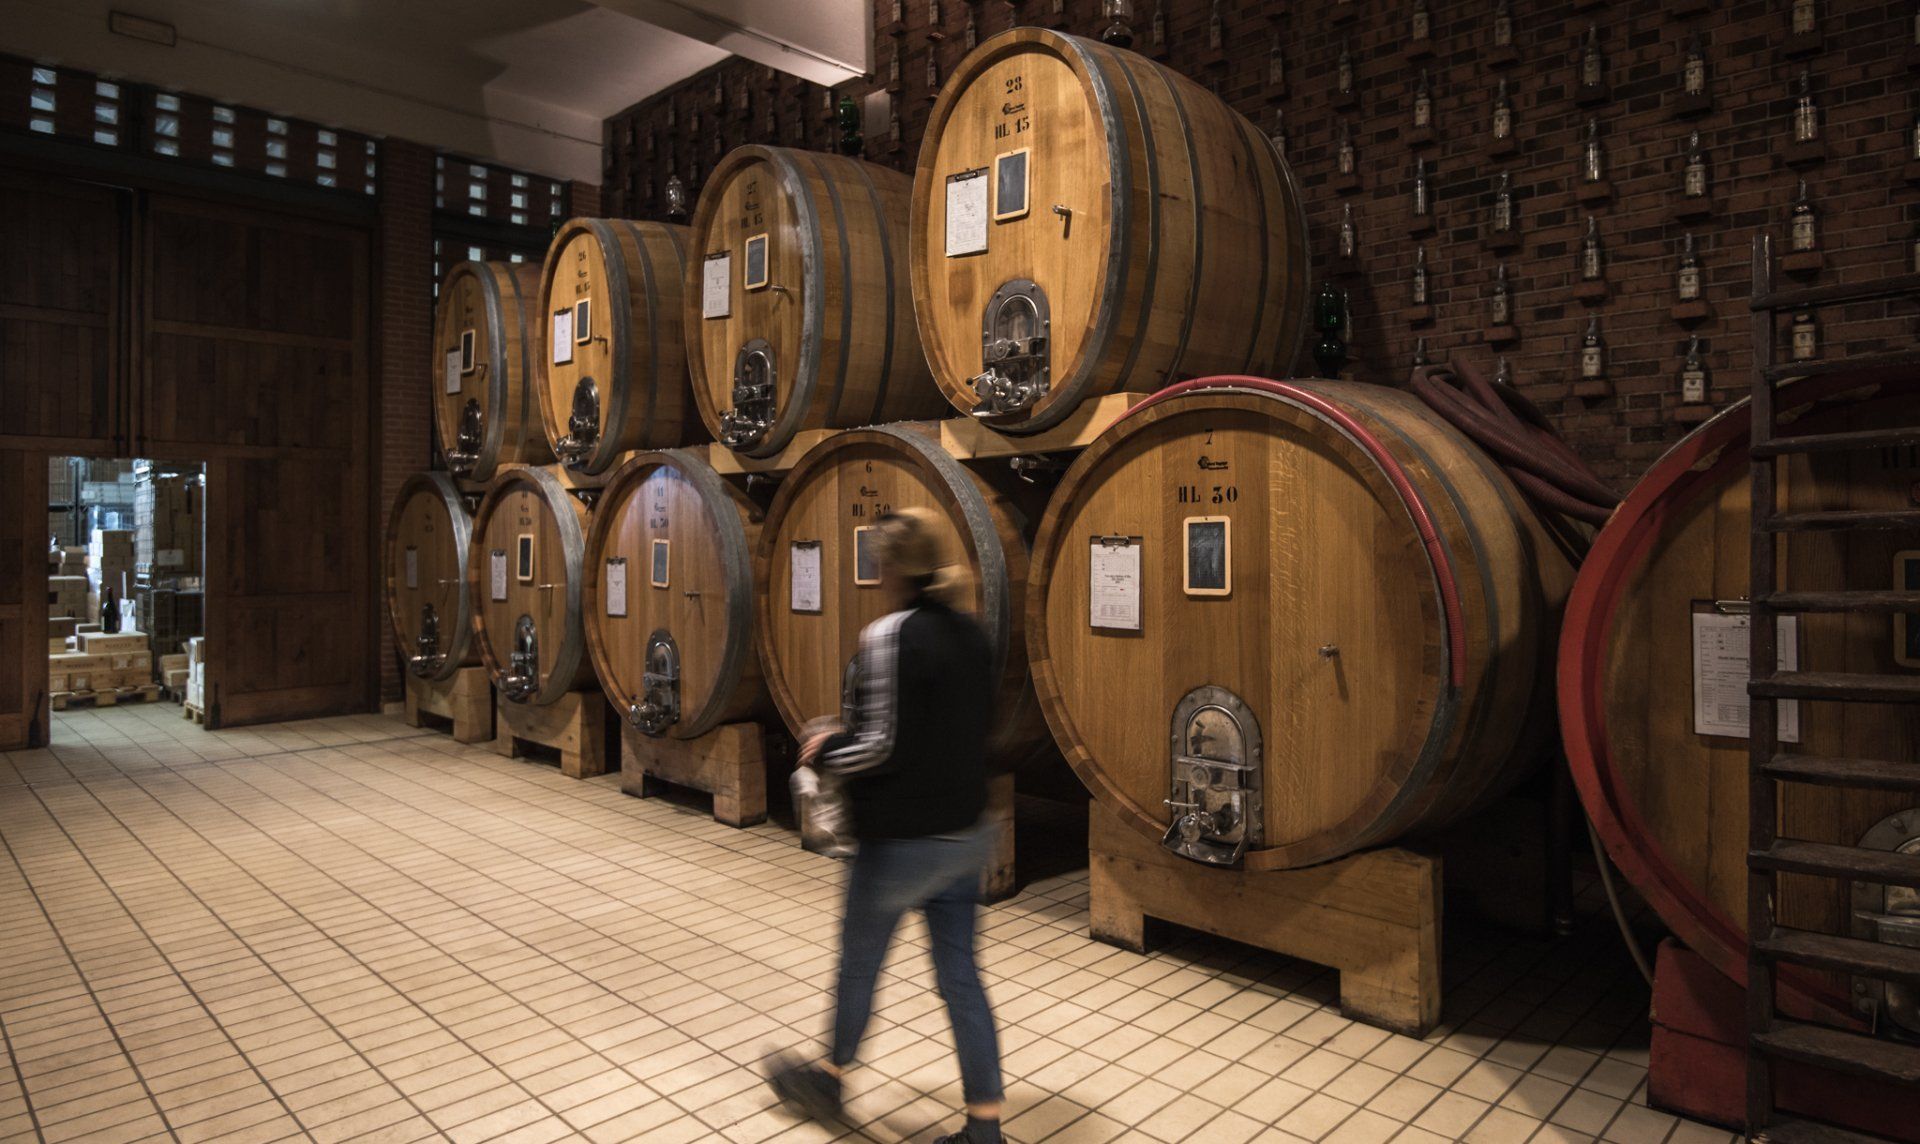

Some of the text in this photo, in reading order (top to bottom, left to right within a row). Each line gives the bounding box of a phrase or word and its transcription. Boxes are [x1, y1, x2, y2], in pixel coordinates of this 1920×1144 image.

[1016, 116, 1030, 133] 15
[1204, 428, 1214, 445] 7
[865, 461, 872, 473] 6
[1178, 486, 1239, 504] HL 30
